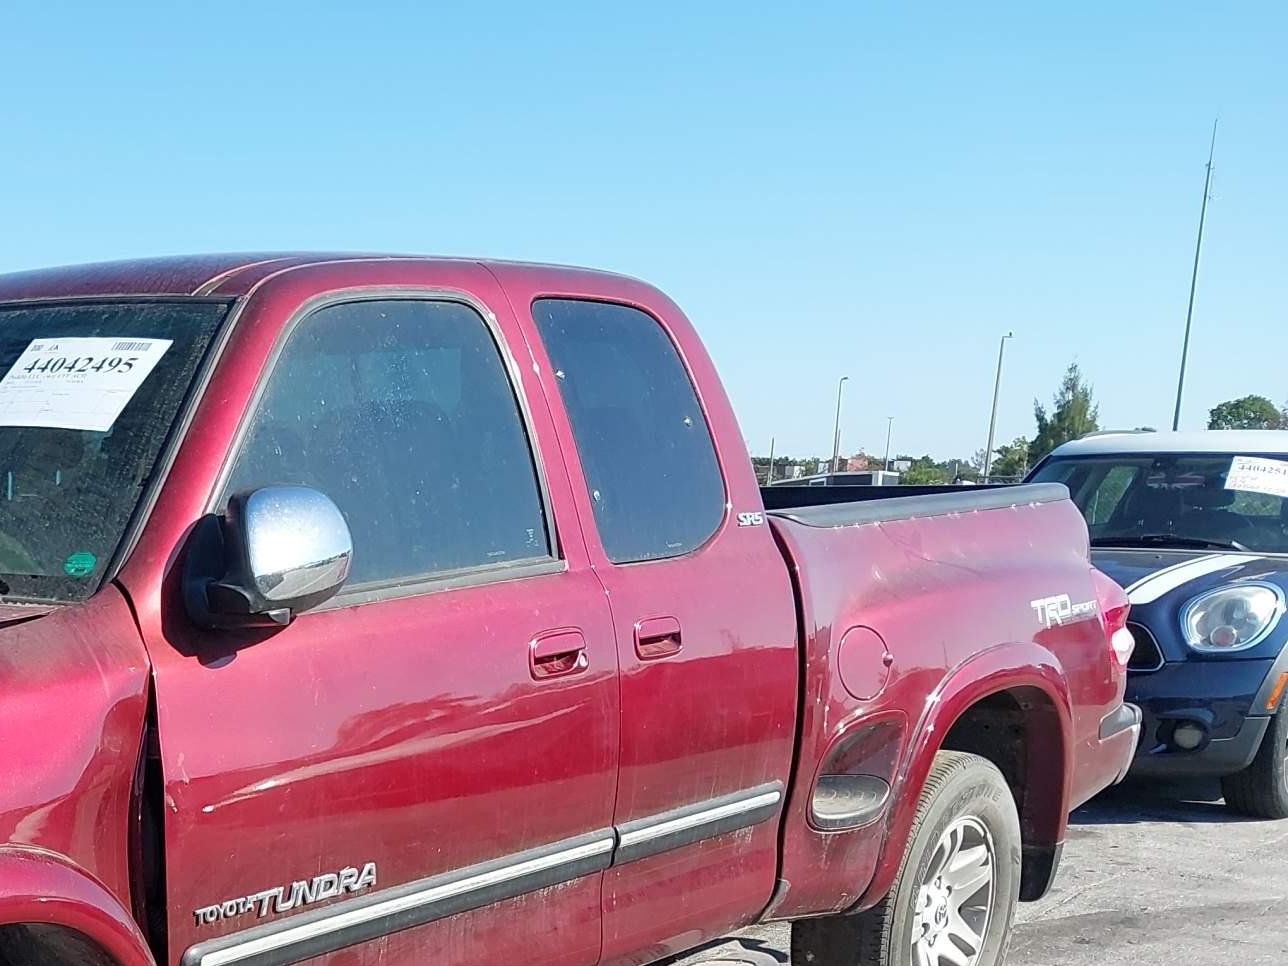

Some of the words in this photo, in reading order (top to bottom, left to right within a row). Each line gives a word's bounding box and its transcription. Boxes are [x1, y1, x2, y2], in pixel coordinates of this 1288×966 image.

[23, 356, 139, 374] 44042495
[737, 511, 764, 526] SR5
[1030, 593, 1072, 629] TRD
[193, 895, 256, 927] TOYOTA
[254, 862, 377, 919] TUNDRA
